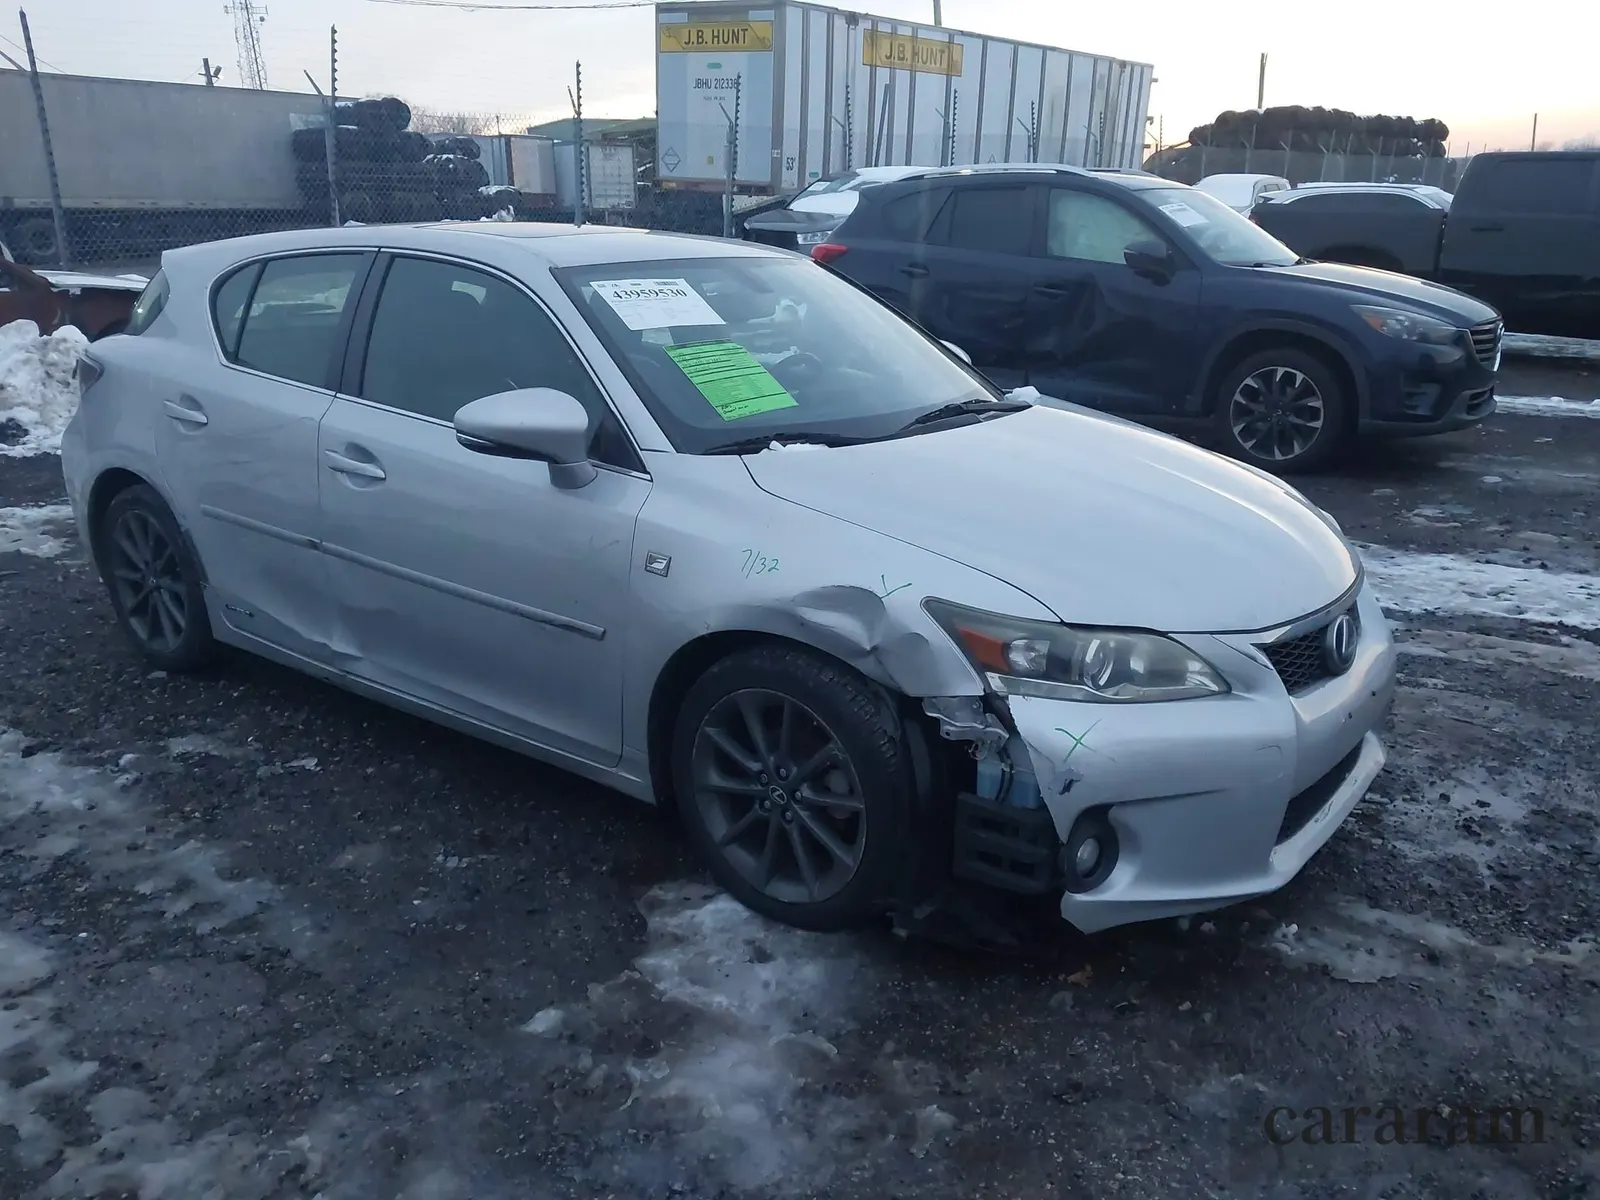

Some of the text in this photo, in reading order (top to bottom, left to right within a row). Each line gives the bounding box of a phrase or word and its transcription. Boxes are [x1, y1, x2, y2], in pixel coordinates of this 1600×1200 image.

[683, 28, 749, 45] J.B. HUNT
[884, 40, 946, 67] J.B. HUNT
[693, 77, 712, 90] JBHU
[612, 288, 688, 300] 43959530
[741, 549, 779, 579] 7/32
